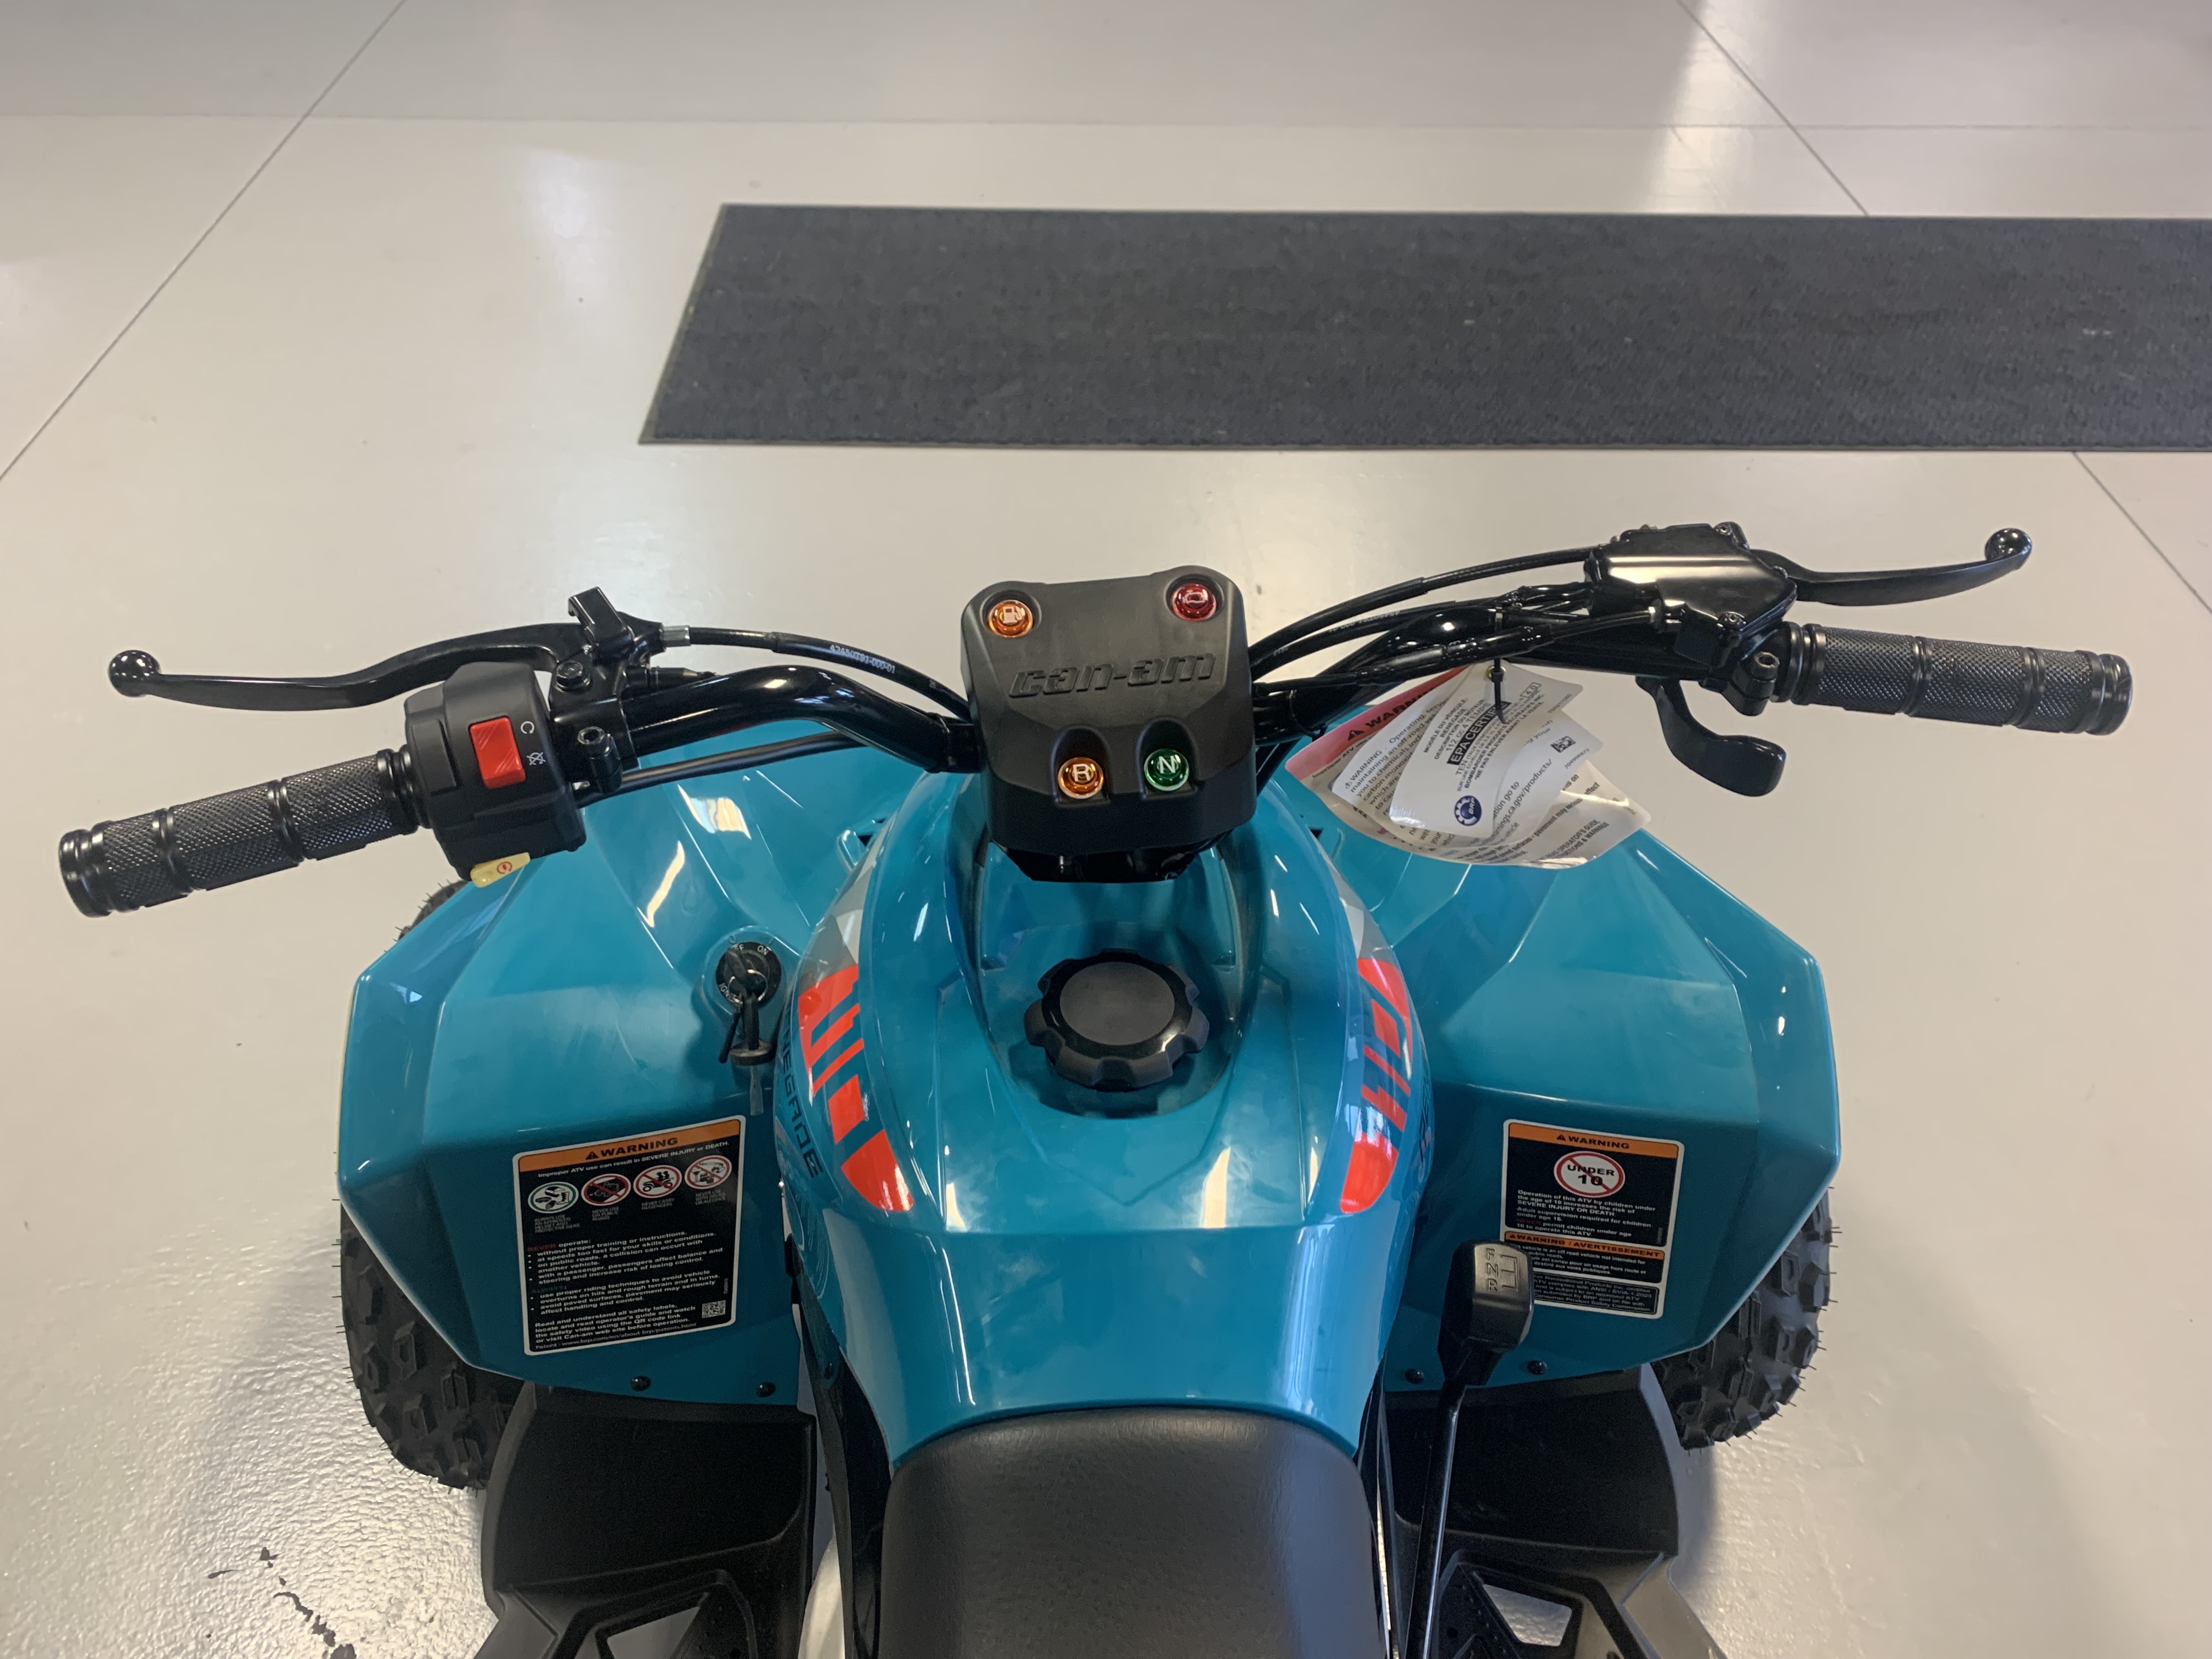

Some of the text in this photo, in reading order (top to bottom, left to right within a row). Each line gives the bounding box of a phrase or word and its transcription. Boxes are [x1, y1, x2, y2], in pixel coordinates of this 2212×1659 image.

[1008, 652, 1216, 698] can-am
[1437, 720, 1446, 729] DU
[1440, 708, 1467, 737] RENEGADE
[1445, 739, 1457, 750] 112
[1465, 704, 1492, 721] TEMPS
[1532, 728, 1550, 739] your
[1434, 724, 1459, 759] DESCRIPTION
[1480, 757, 1489, 768] PAS
[1487, 735, 1508, 756] ENLEVER
[1505, 721, 1520, 734] AVANT
[1341, 747, 1355, 758] ATV
[1450, 743, 1470, 762] EPA
[1465, 726, 1507, 788] BOMBARDIER PRODUITS
[1073, 762, 1091, 782] R
[1158, 755, 1177, 774] N
[1350, 749, 1382, 781] WARNING
[1351, 754, 1388, 793] maintaining
[1387, 746, 1398, 756] an
[1357, 784, 1369, 797] you
[1376, 747, 1409, 776] chemicals
[1455, 761, 1468, 775] TEN
[1570, 774, 1579, 783] on
[1362, 778, 1385, 801] carbon
[1368, 776, 1400, 805] which are
[1503, 781, 1521, 800] go to
[1374, 802, 1384, 810] to
[1533, 816, 1558, 836] pavement
[1555, 808, 1568, 819] may
[1584, 820, 1600, 831] GUIDE
[1585, 822, 1609, 838] WARNINGS
[757, 945, 769, 955] ON
[600, 1136, 678, 1158] WARNING
[1567, 1135, 1630, 1149] WARNING
[641, 1153, 668, 1161] SEVERE
[670, 1147, 695, 1156] INJURY
[1567, 1164, 1615, 1176] UNDER
[1577, 1173, 1604, 1186] 10
[1517, 1190, 1552, 1198] Operation
[537, 1248, 567, 1256] without
[568, 1244, 595, 1252] proper
[639, 1231, 687, 1242] instructions.
[674, 1233, 716, 1242] conditions.
[528, 1239, 590, 1252] NEVER operate:
[1517, 1234, 1565, 1245] WARNING
[1573, 1242, 1660, 1257] AVERTISSEMENT
[1486, 1248, 1496, 1260] F
[1487, 1262, 1499, 1277] N
[1488, 1278, 1498, 1291] R
[573, 1311, 616, 1322] understand
[595, 1316, 633, 1324] operator's
[653, 1318, 690, 1327] operation.
